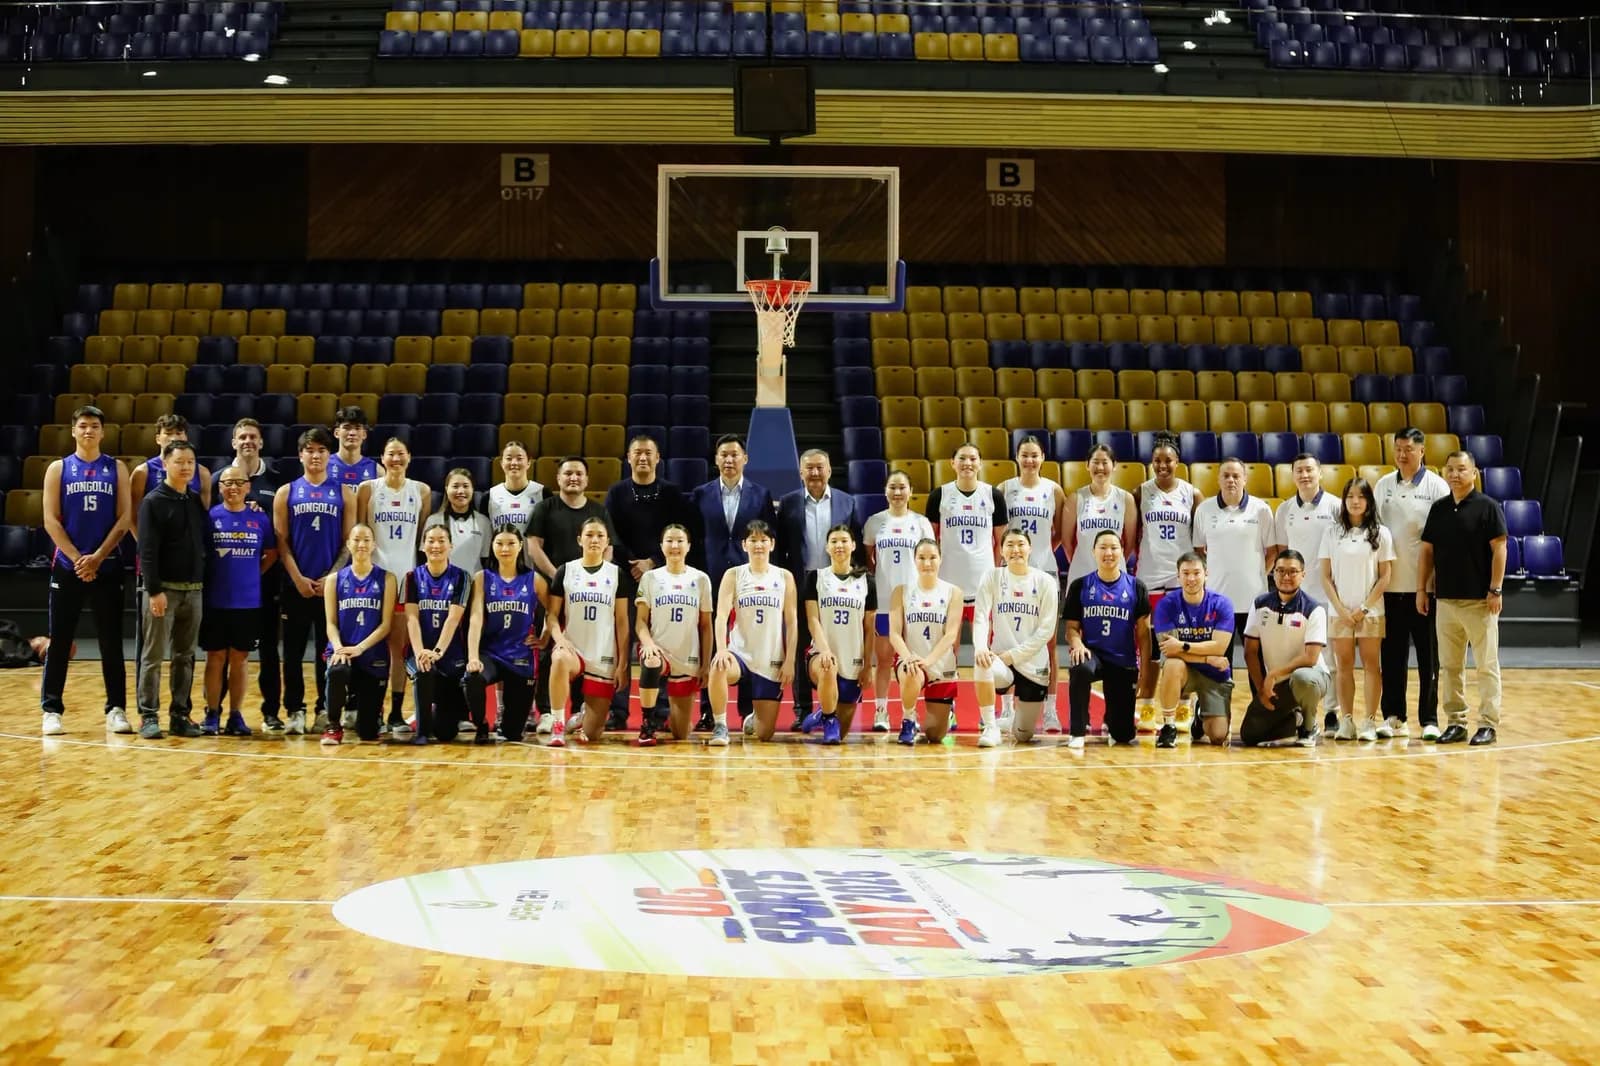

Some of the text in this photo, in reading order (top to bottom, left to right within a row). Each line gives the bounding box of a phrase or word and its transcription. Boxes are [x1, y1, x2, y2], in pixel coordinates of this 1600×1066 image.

[514, 158, 535, 182] B
[1000, 163, 1020, 187] B
[501, 188, 544, 200] 01-17
[990, 193, 1032, 207] 18-36
[66, 481, 113, 495] MONGOLIA
[83, 495, 97, 511] 15
[293, 502, 338, 517] MONGOLIA
[374, 511, 416, 525] MONGOLIA
[1008, 506, 1049, 519] MONGOLIA
[1145, 511, 1188, 524] MONGOLIA
[311, 515, 320, 531] 4
[945, 515, 987, 528] MONGOLIA
[1021, 520, 1037, 534] 24
[1080, 518, 1120, 531] MONGOLIA
[389, 525, 403, 539] 14
[961, 529, 973, 544] 13
[1159, 524, 1175, 540] 32
[893, 550, 901, 564] 3
[339, 597, 380, 611] MONGOLIA
[569, 591, 611, 608] MONGOLIA
[655, 594, 698, 608] MONGOLIA
[738, 596, 780, 609] MONGOLIA
[820, 597, 861, 610] MONGOLIA
[486, 601, 529, 615] MONGOLIA
[584, 606, 597, 621] 10
[671, 607, 683, 622] 16
[997, 602, 1040, 617] MONGOLIA
[1083, 605, 1129, 620] MONGOLIA
[356, 611, 365, 626] 4
[503, 613, 512, 629] 8
[756, 609, 764, 624] 5
[834, 610, 849, 625] 33
[906, 611, 947, 625] MONGOLIA
[1014, 616, 1021, 631] 7
[923, 626, 930, 640] 4
[1101, 620, 1111, 636] 3
[813, 869, 916, 903] 2026
[633, 886, 734, 917] UG
[720, 869, 856, 946] SPORTS
[835, 902, 965, 950] DAY
